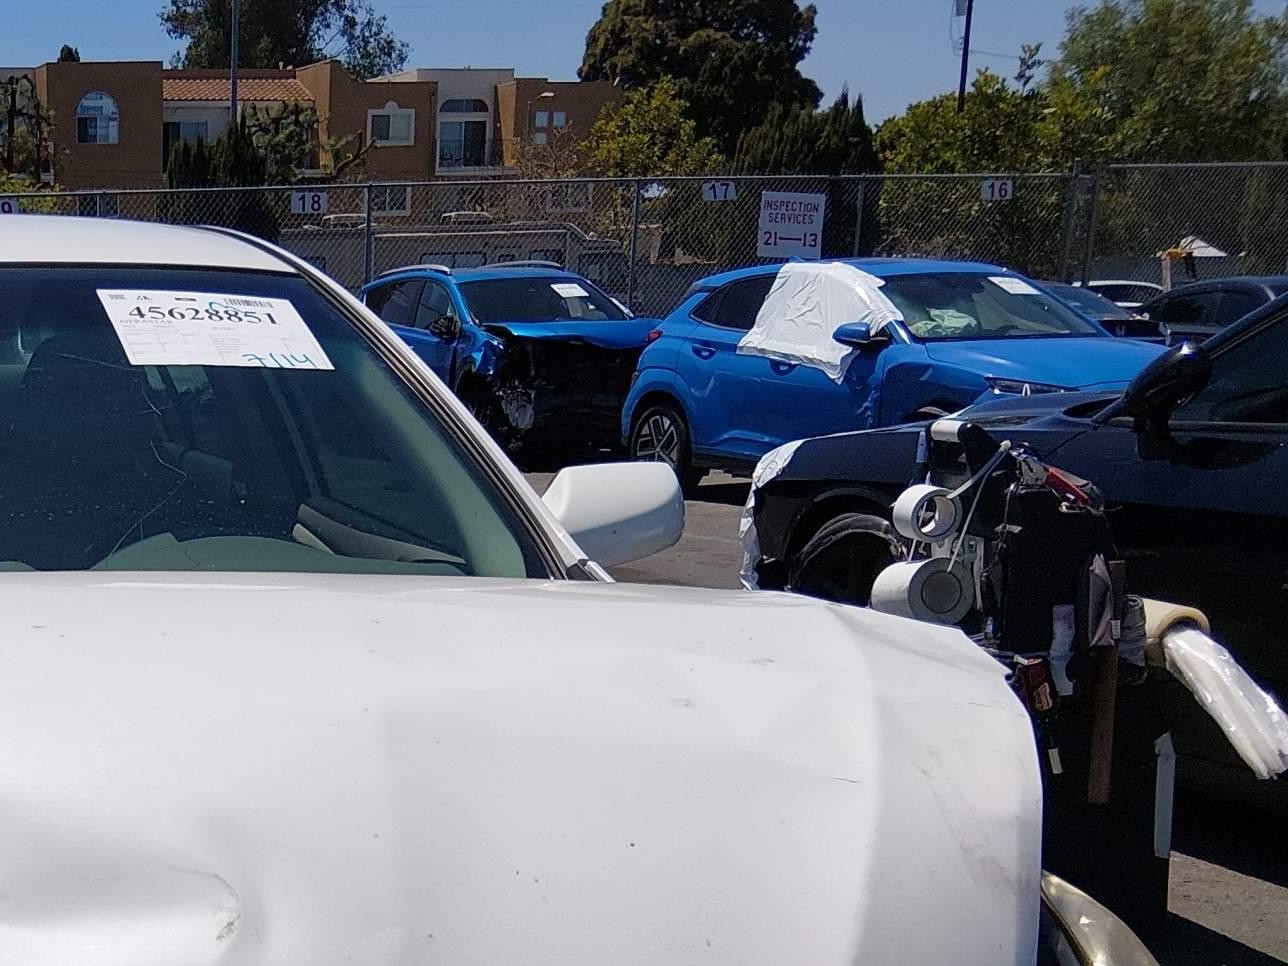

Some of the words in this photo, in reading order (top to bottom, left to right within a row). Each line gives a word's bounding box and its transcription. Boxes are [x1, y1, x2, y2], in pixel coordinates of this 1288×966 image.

[708, 183, 730, 199] 17
[988, 181, 1008, 200] 16
[298, 193, 322, 212] 18
[763, 200, 819, 213] INSPECTION
[768, 212, 814, 225] SERVICES
[128, 305, 279, 325] 45628851
[242, 352, 318, 368] 7/14
